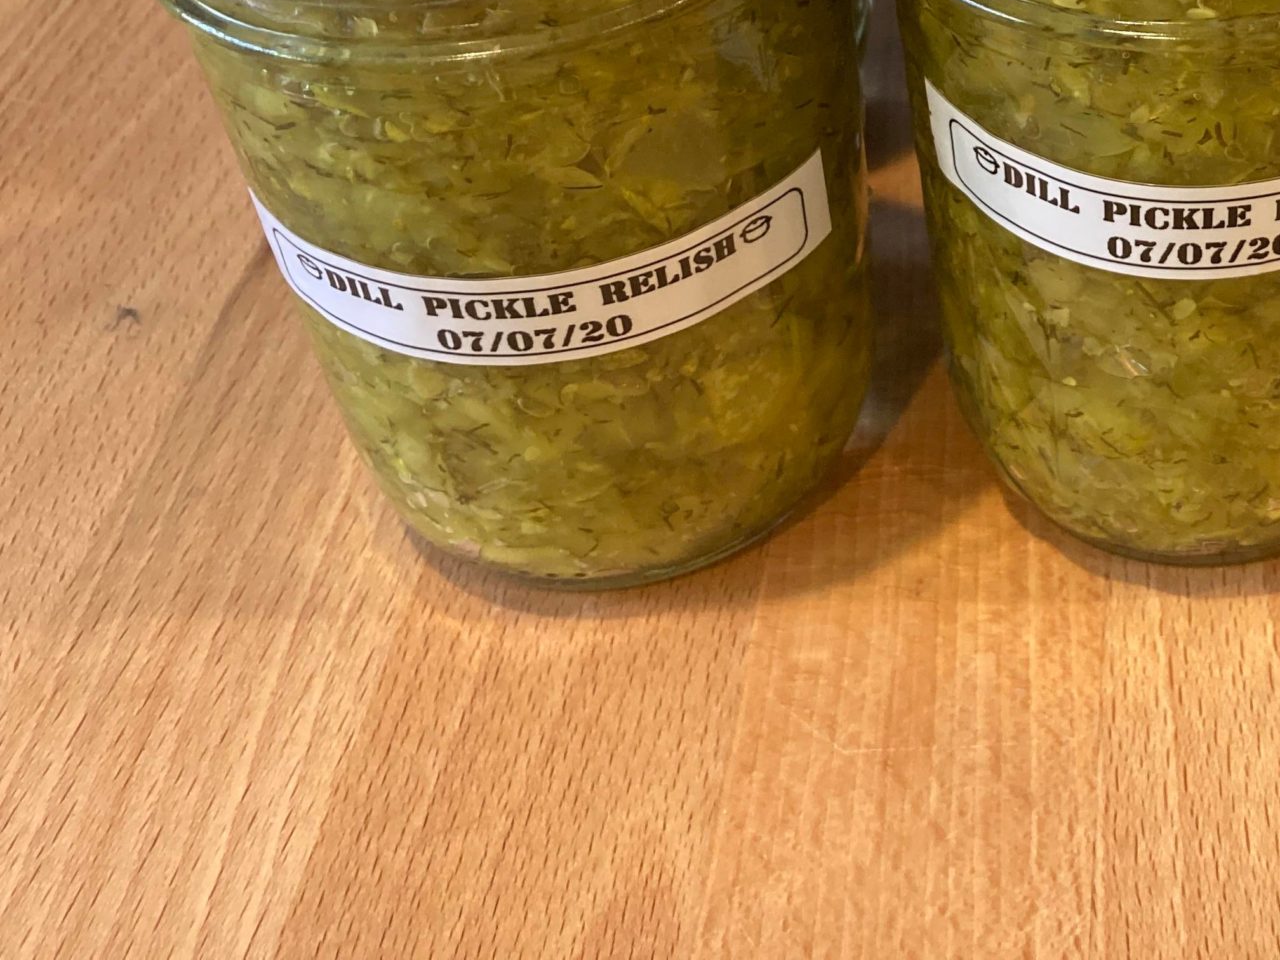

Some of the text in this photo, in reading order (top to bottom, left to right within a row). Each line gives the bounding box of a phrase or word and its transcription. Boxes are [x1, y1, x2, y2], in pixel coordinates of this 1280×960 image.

[1002, 161, 1081, 215] DILL
[1102, 201, 1253, 230] PICKLE
[326, 232, 738, 321] DILL PICKLE RELISH
[436, 313, 634, 354] 07/07/20
